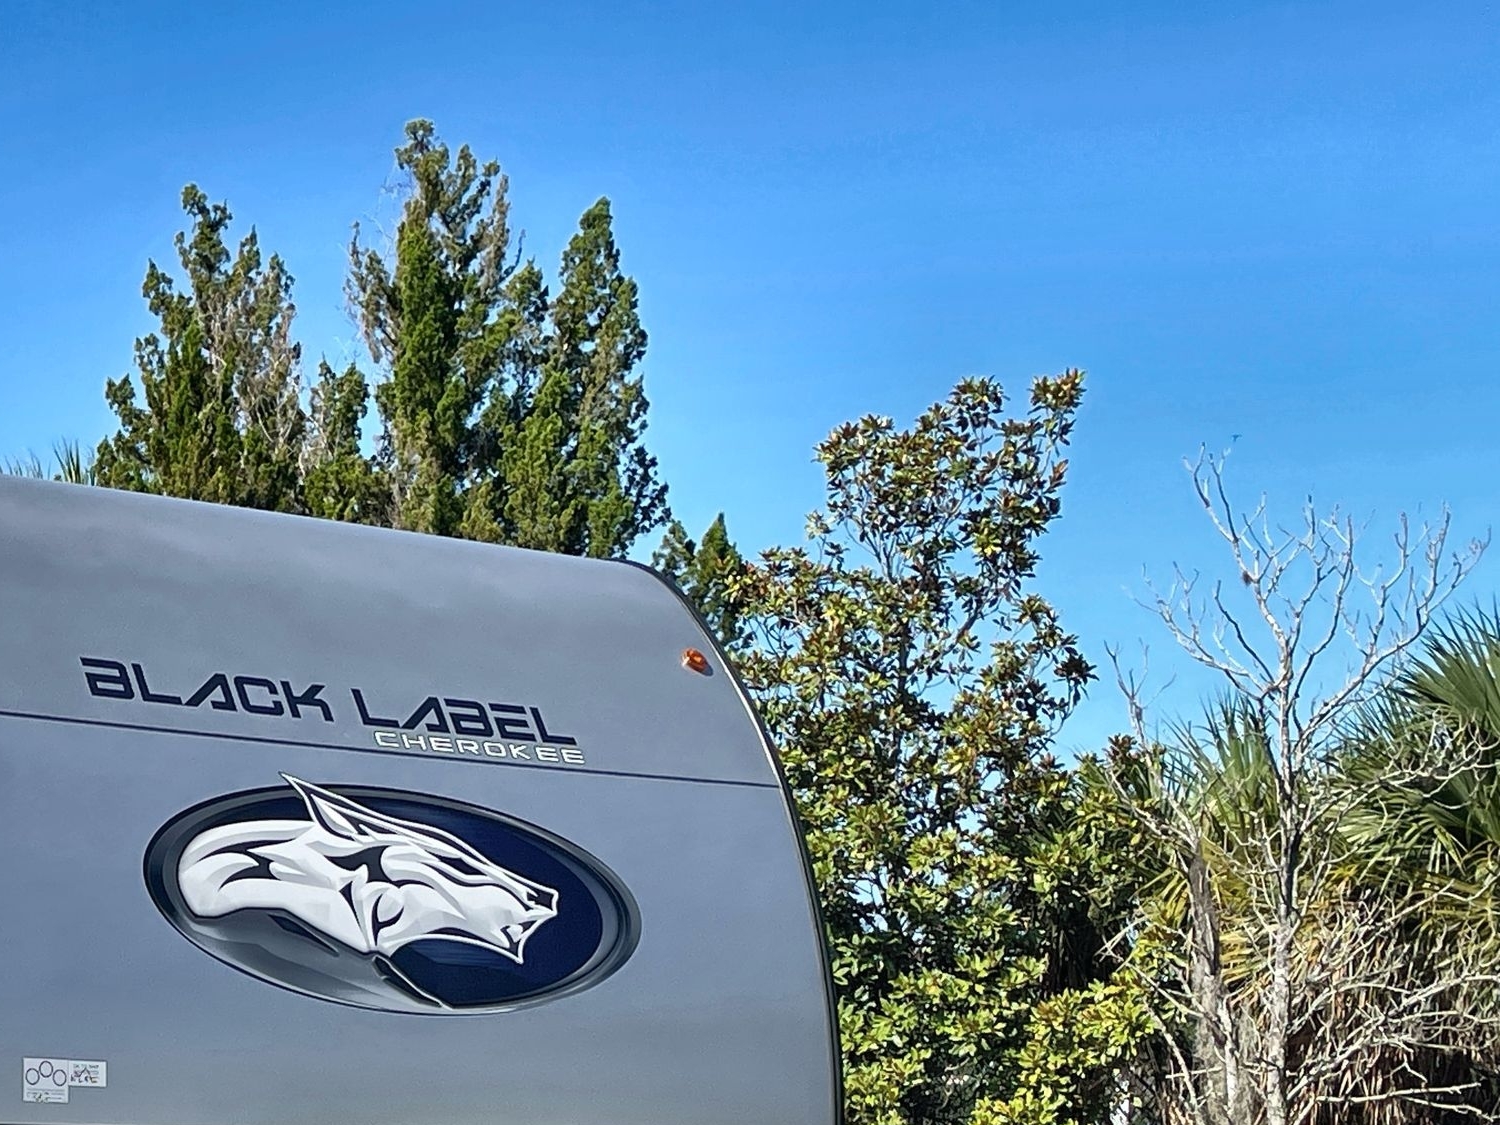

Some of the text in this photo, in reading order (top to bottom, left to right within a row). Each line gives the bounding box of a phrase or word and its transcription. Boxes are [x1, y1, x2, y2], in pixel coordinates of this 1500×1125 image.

[79, 656, 577, 746] BLACK LABEL
[374, 730, 586, 765] CHEROKEE
